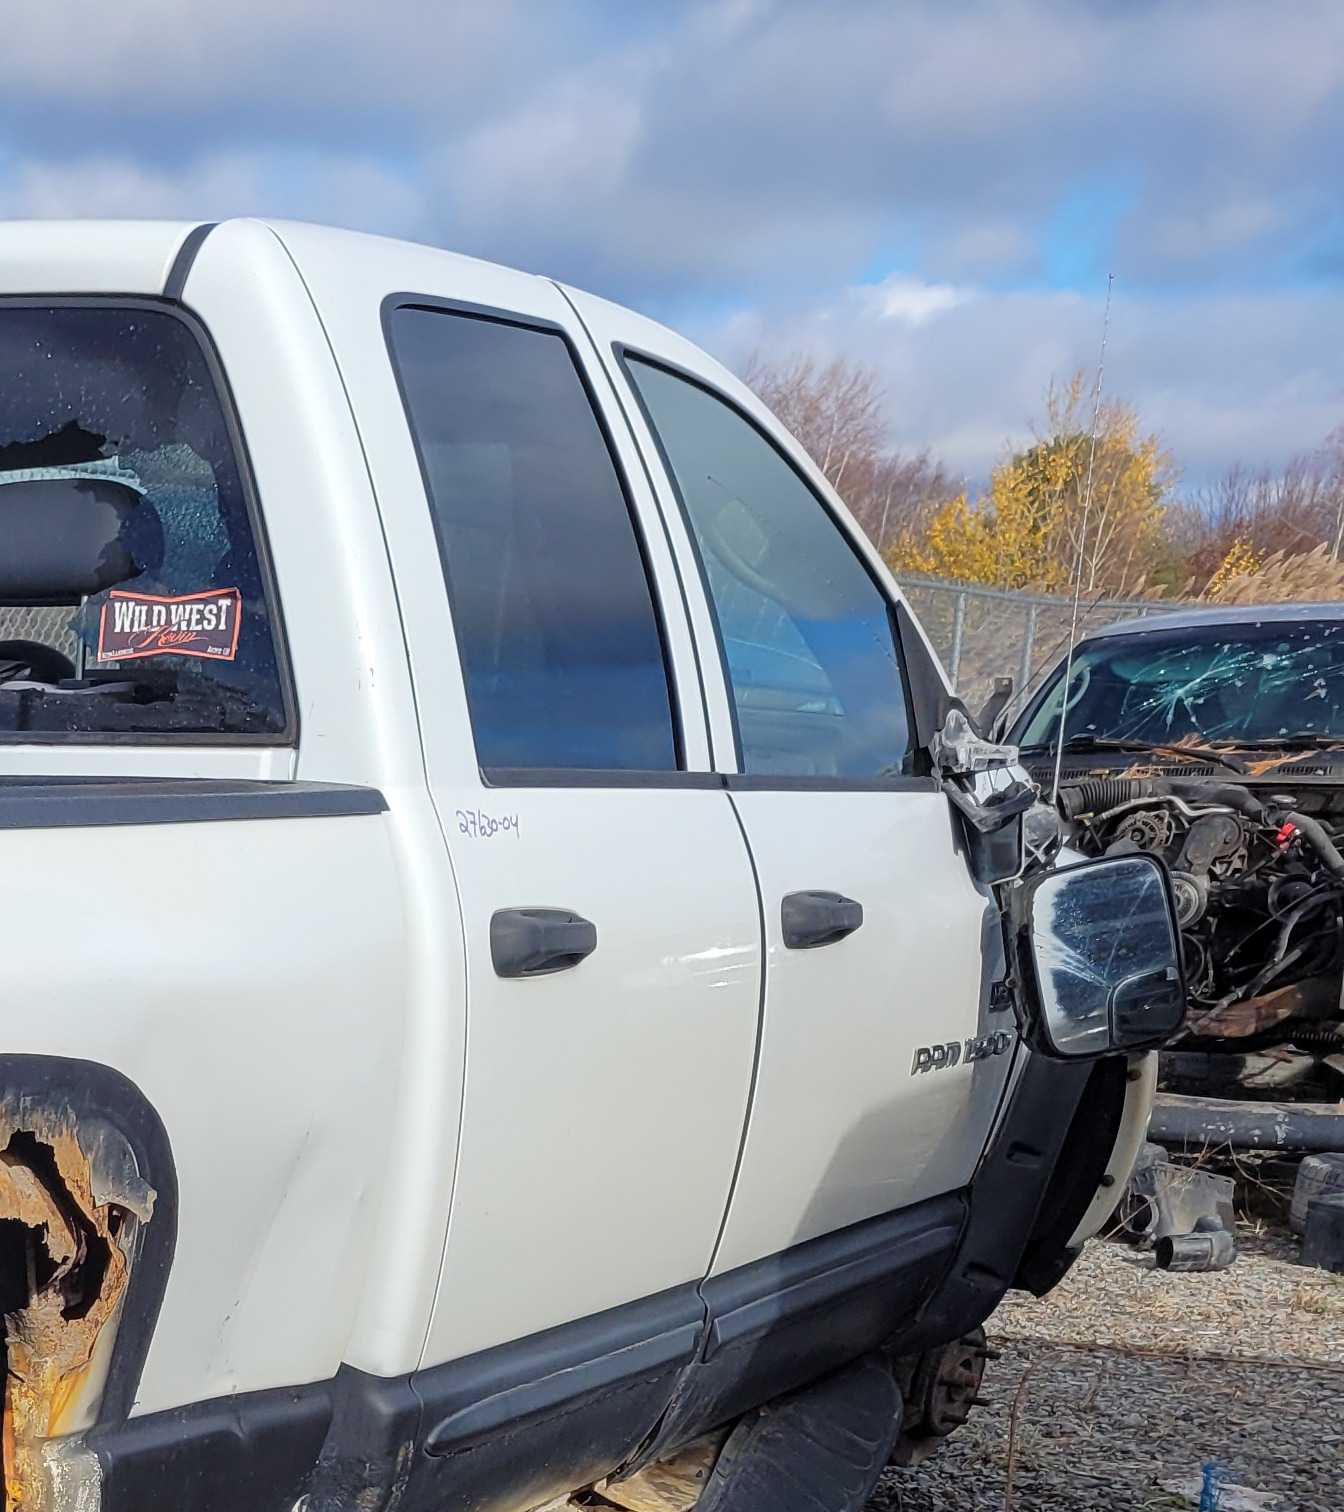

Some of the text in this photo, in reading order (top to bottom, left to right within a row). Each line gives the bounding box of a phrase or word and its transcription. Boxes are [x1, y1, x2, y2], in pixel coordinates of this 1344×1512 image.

[113, 598, 232, 633] WILD WEST
[455, 807, 520, 840] 27630-04
[910, 1040, 962, 1077] RAM
